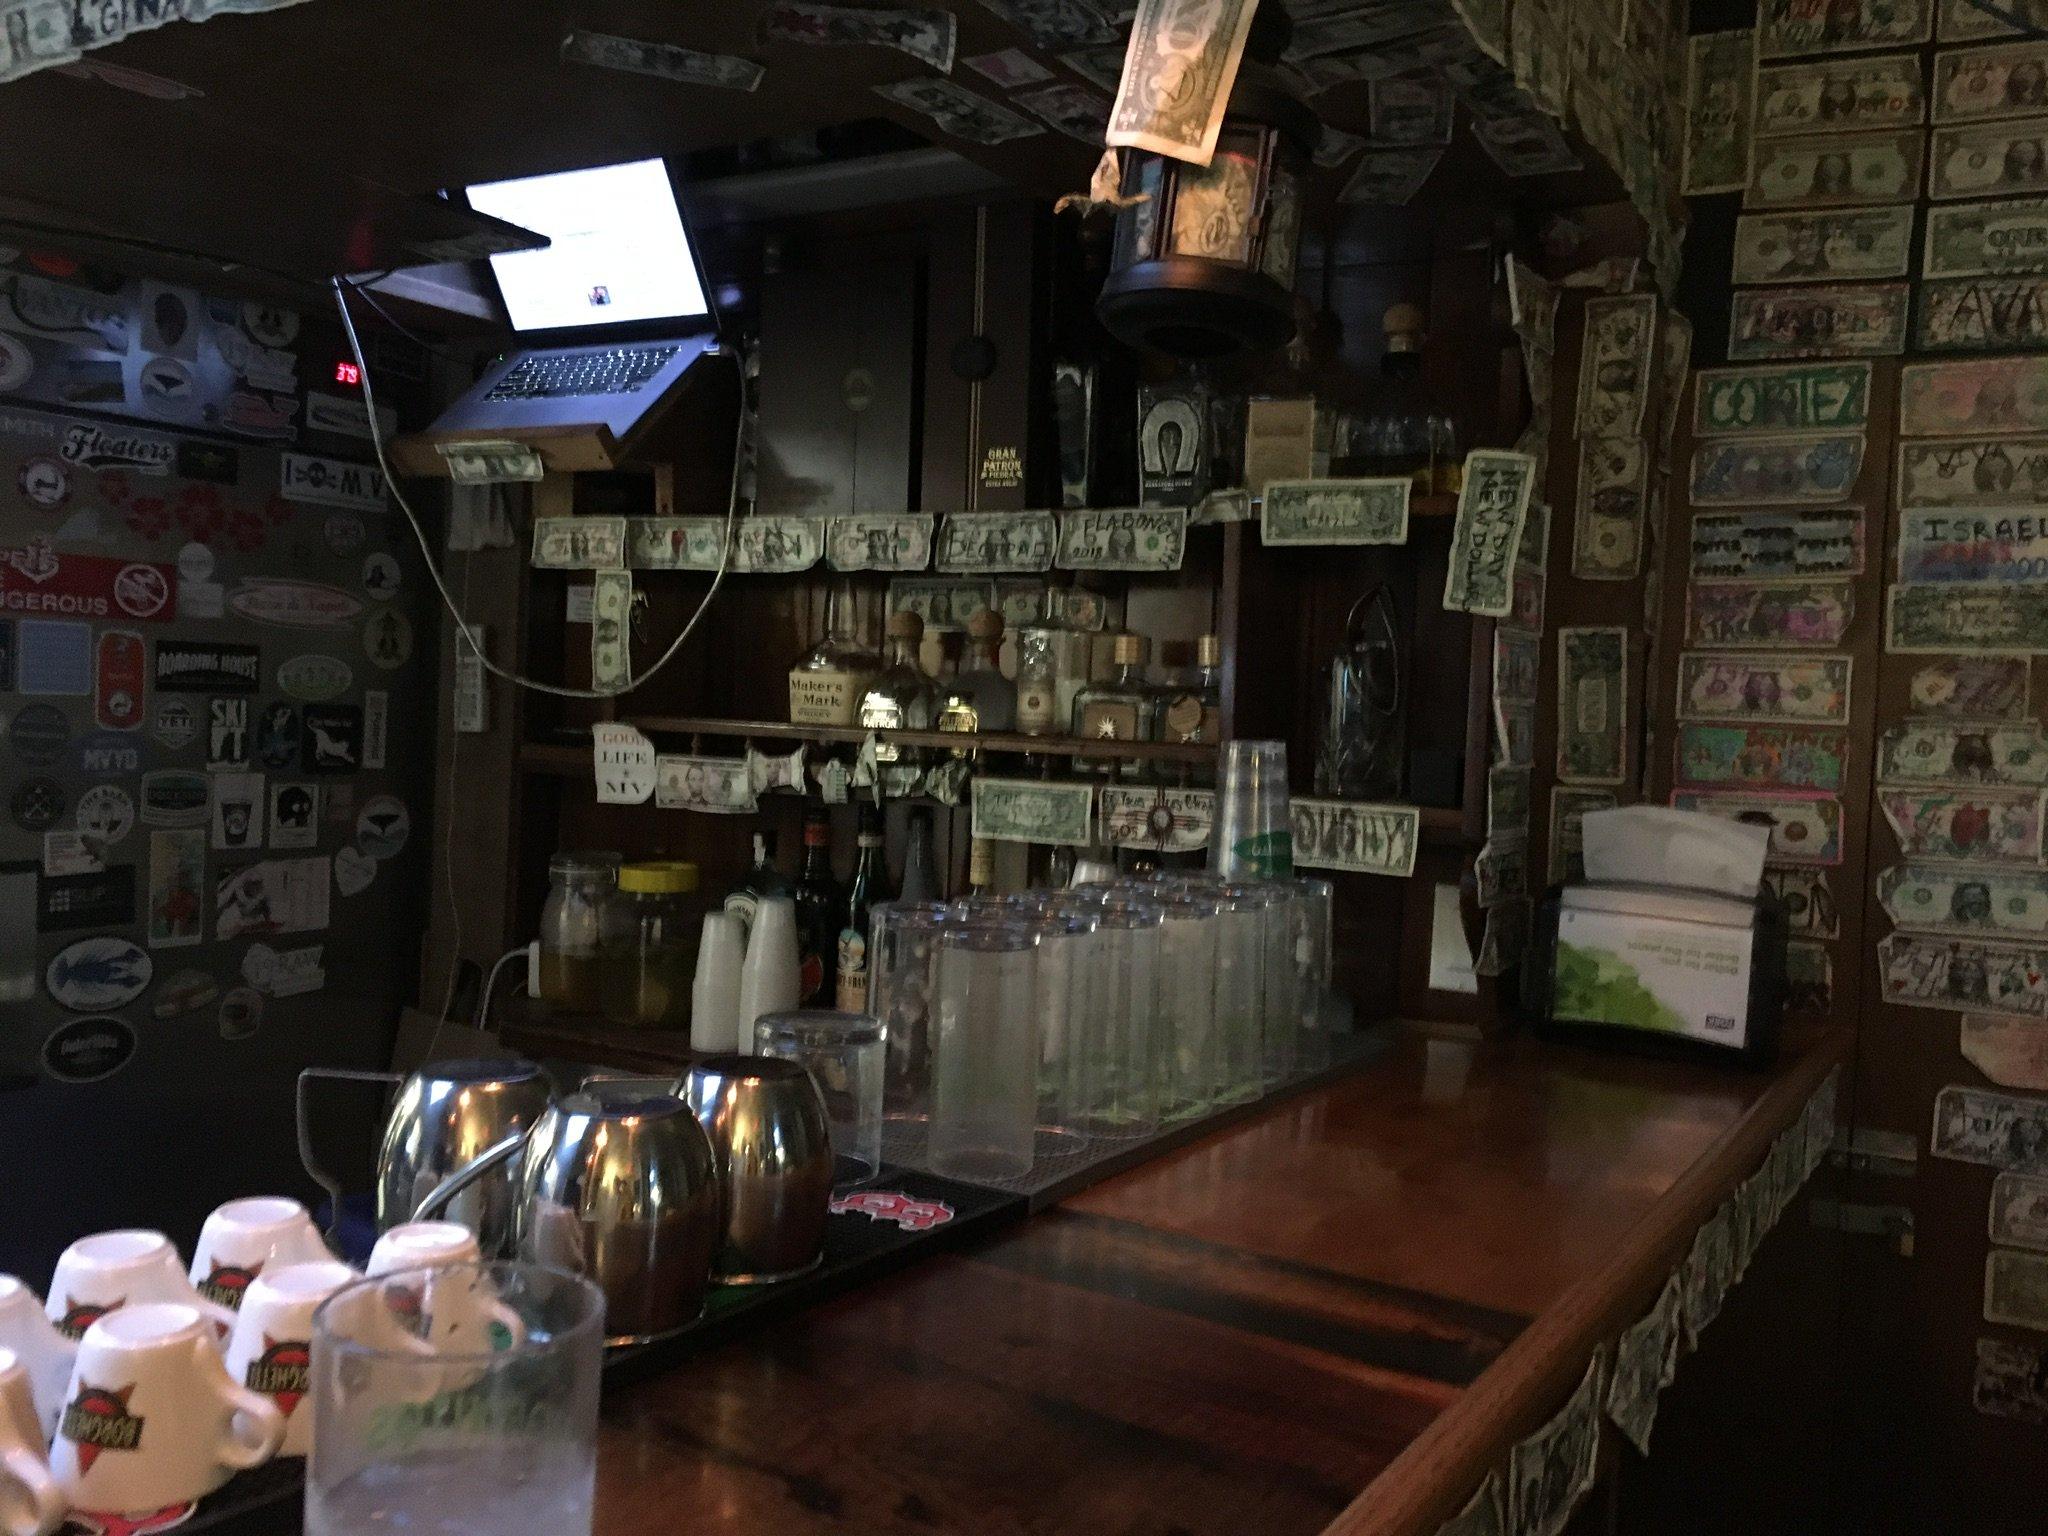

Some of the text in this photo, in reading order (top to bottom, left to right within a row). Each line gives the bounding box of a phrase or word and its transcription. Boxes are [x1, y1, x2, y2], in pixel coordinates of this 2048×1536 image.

[62, 424, 173, 463] Floaters
[988, 446, 1017, 460] GRAN
[1476, 470, 1498, 527] NEW
[1487, 470, 1521, 580] NEW DAY
[0, 590, 108, 616] GEROUS
[791, 678, 843, 693] Maker's
[803, 693, 842, 707] Mark
[211, 699, 247, 726] SKI
[157, 716, 191, 728] YETI
[602, 733, 646, 747] GOOD
[602, 750, 648, 765] LIFE
